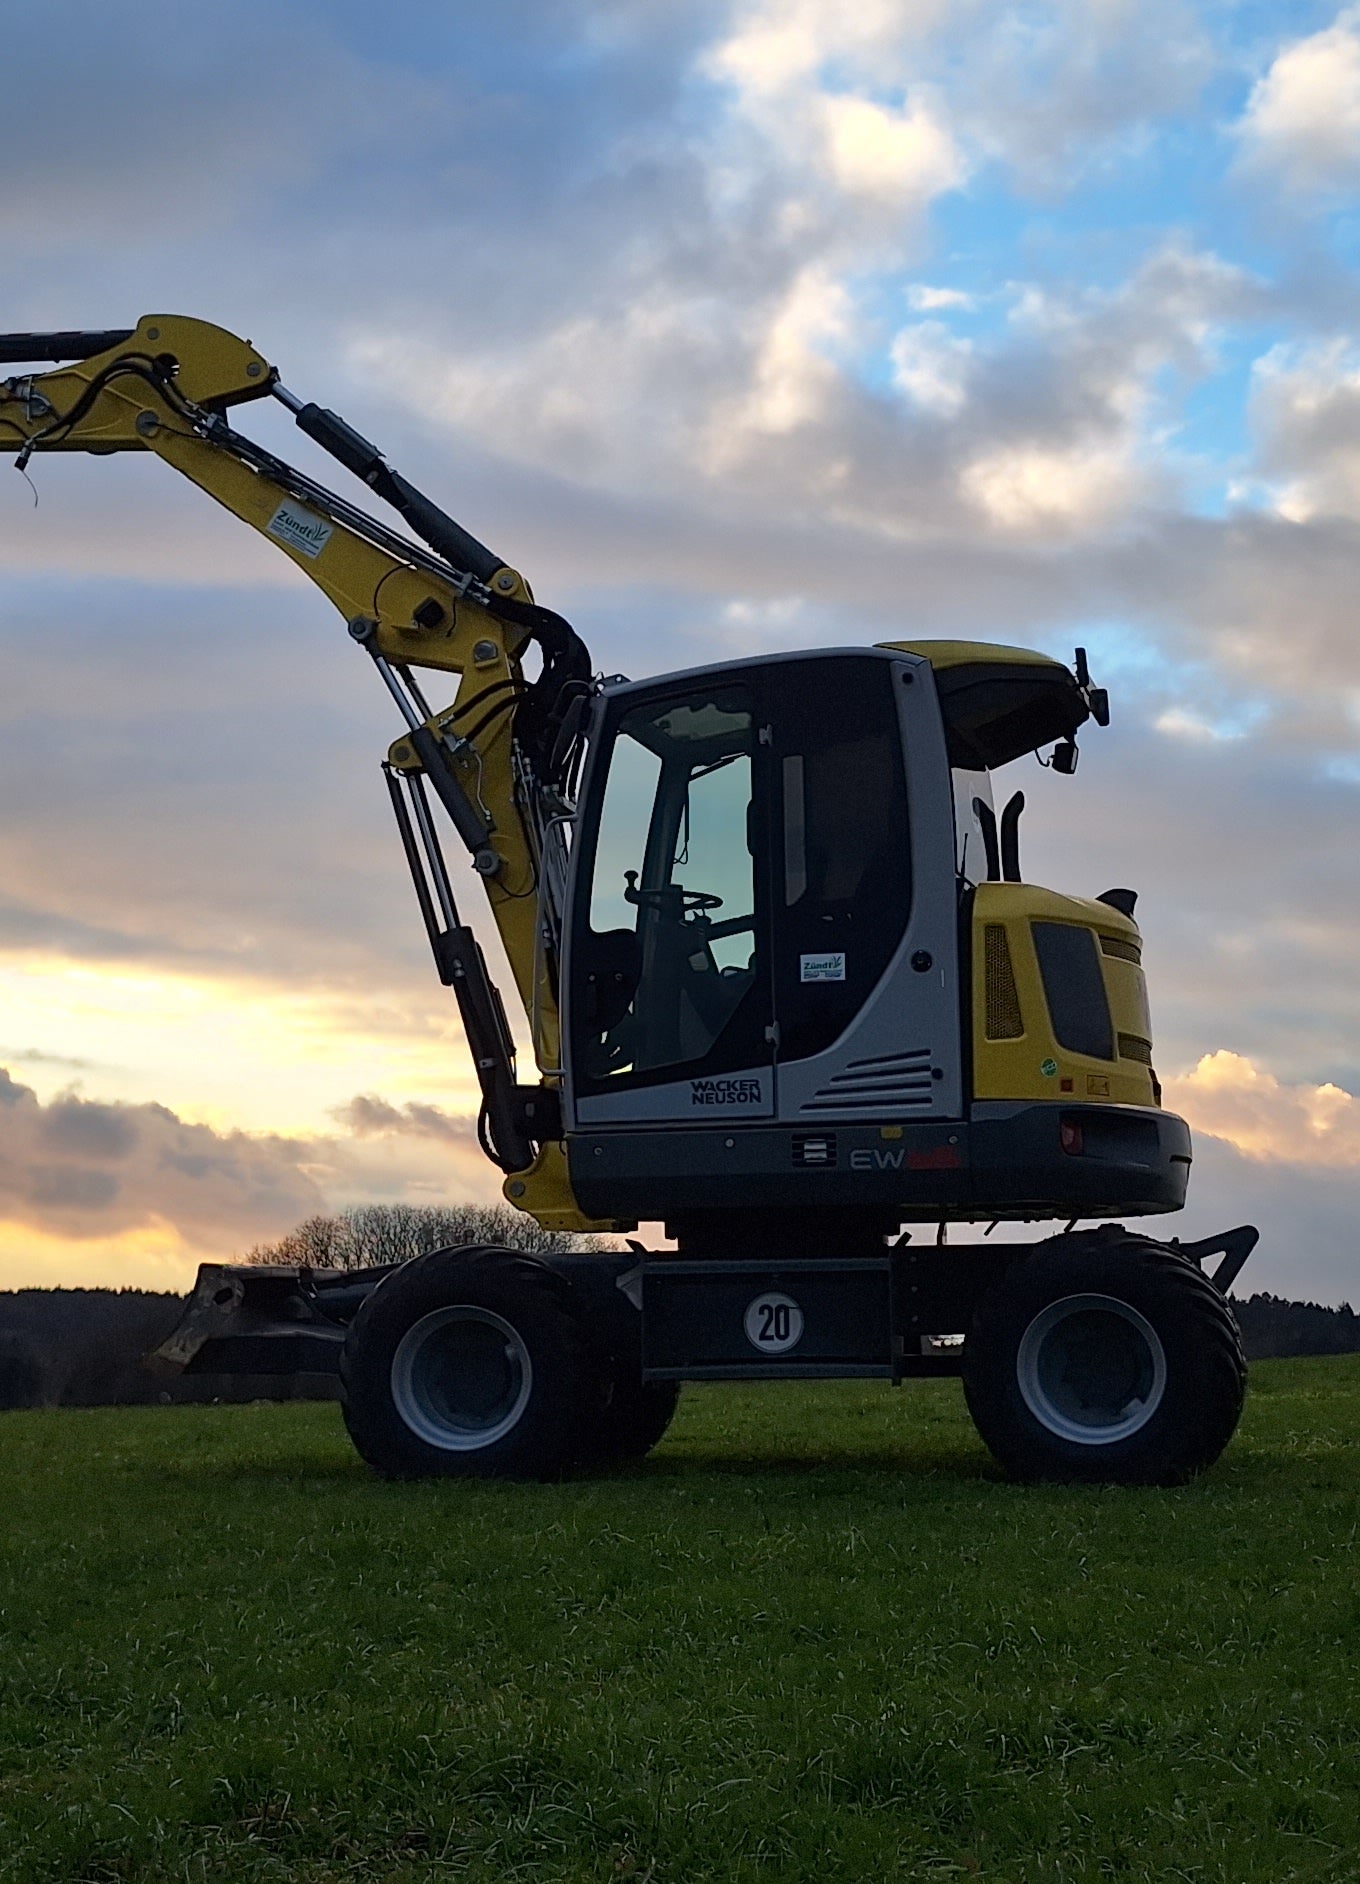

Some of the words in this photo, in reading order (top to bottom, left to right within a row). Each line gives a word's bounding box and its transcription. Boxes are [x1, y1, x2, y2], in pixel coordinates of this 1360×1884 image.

[276, 510, 312, 538] Zündt
[690, 1080, 760, 1092] WACKER
[692, 1090, 761, 1105] NEUSON
[758, 1303, 790, 1341] 20
